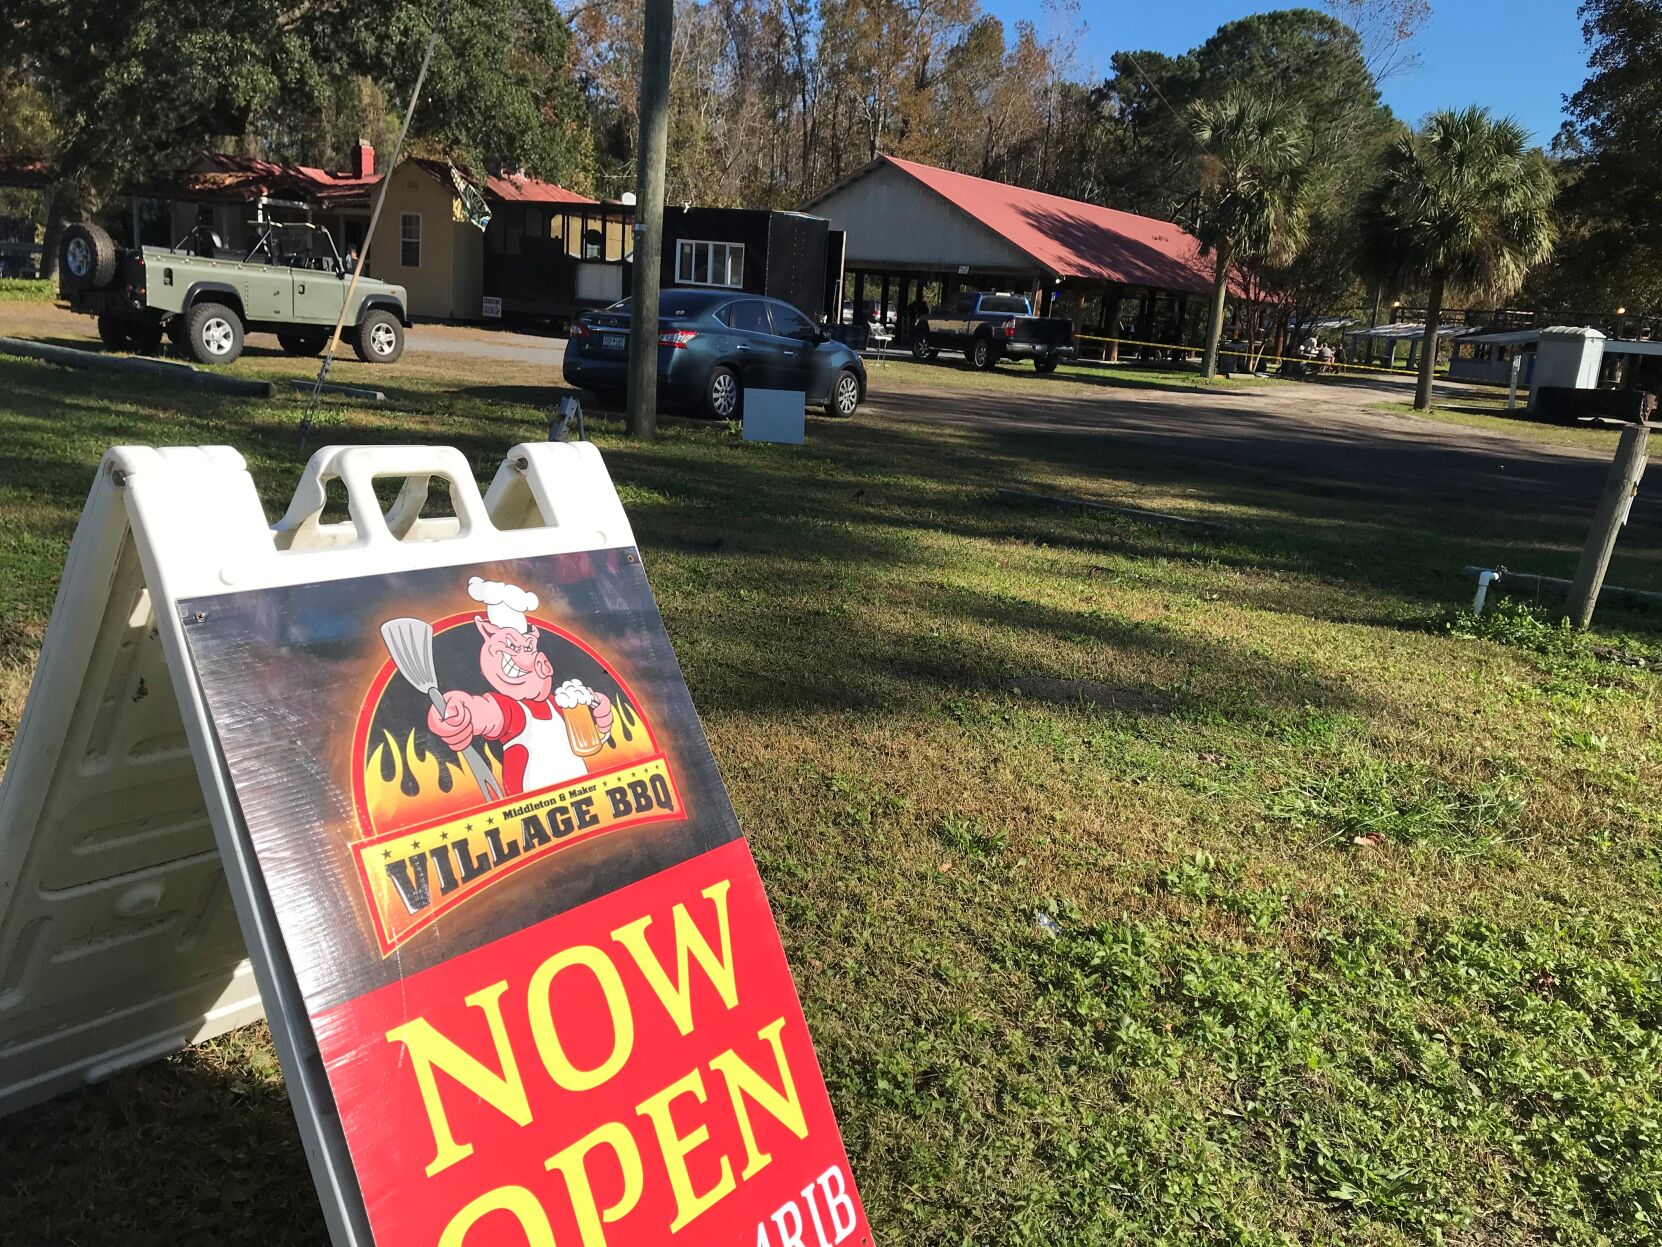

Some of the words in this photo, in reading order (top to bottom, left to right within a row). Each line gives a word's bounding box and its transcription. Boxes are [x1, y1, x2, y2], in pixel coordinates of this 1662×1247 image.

[385, 796, 600, 916] VILLAGE
[605, 773, 675, 819] BBQ
[502, 797, 557, 820] Middleton
[558, 793, 567, 802] &
[568, 784, 597, 799] Maker
[386, 880, 738, 1177] NOW
